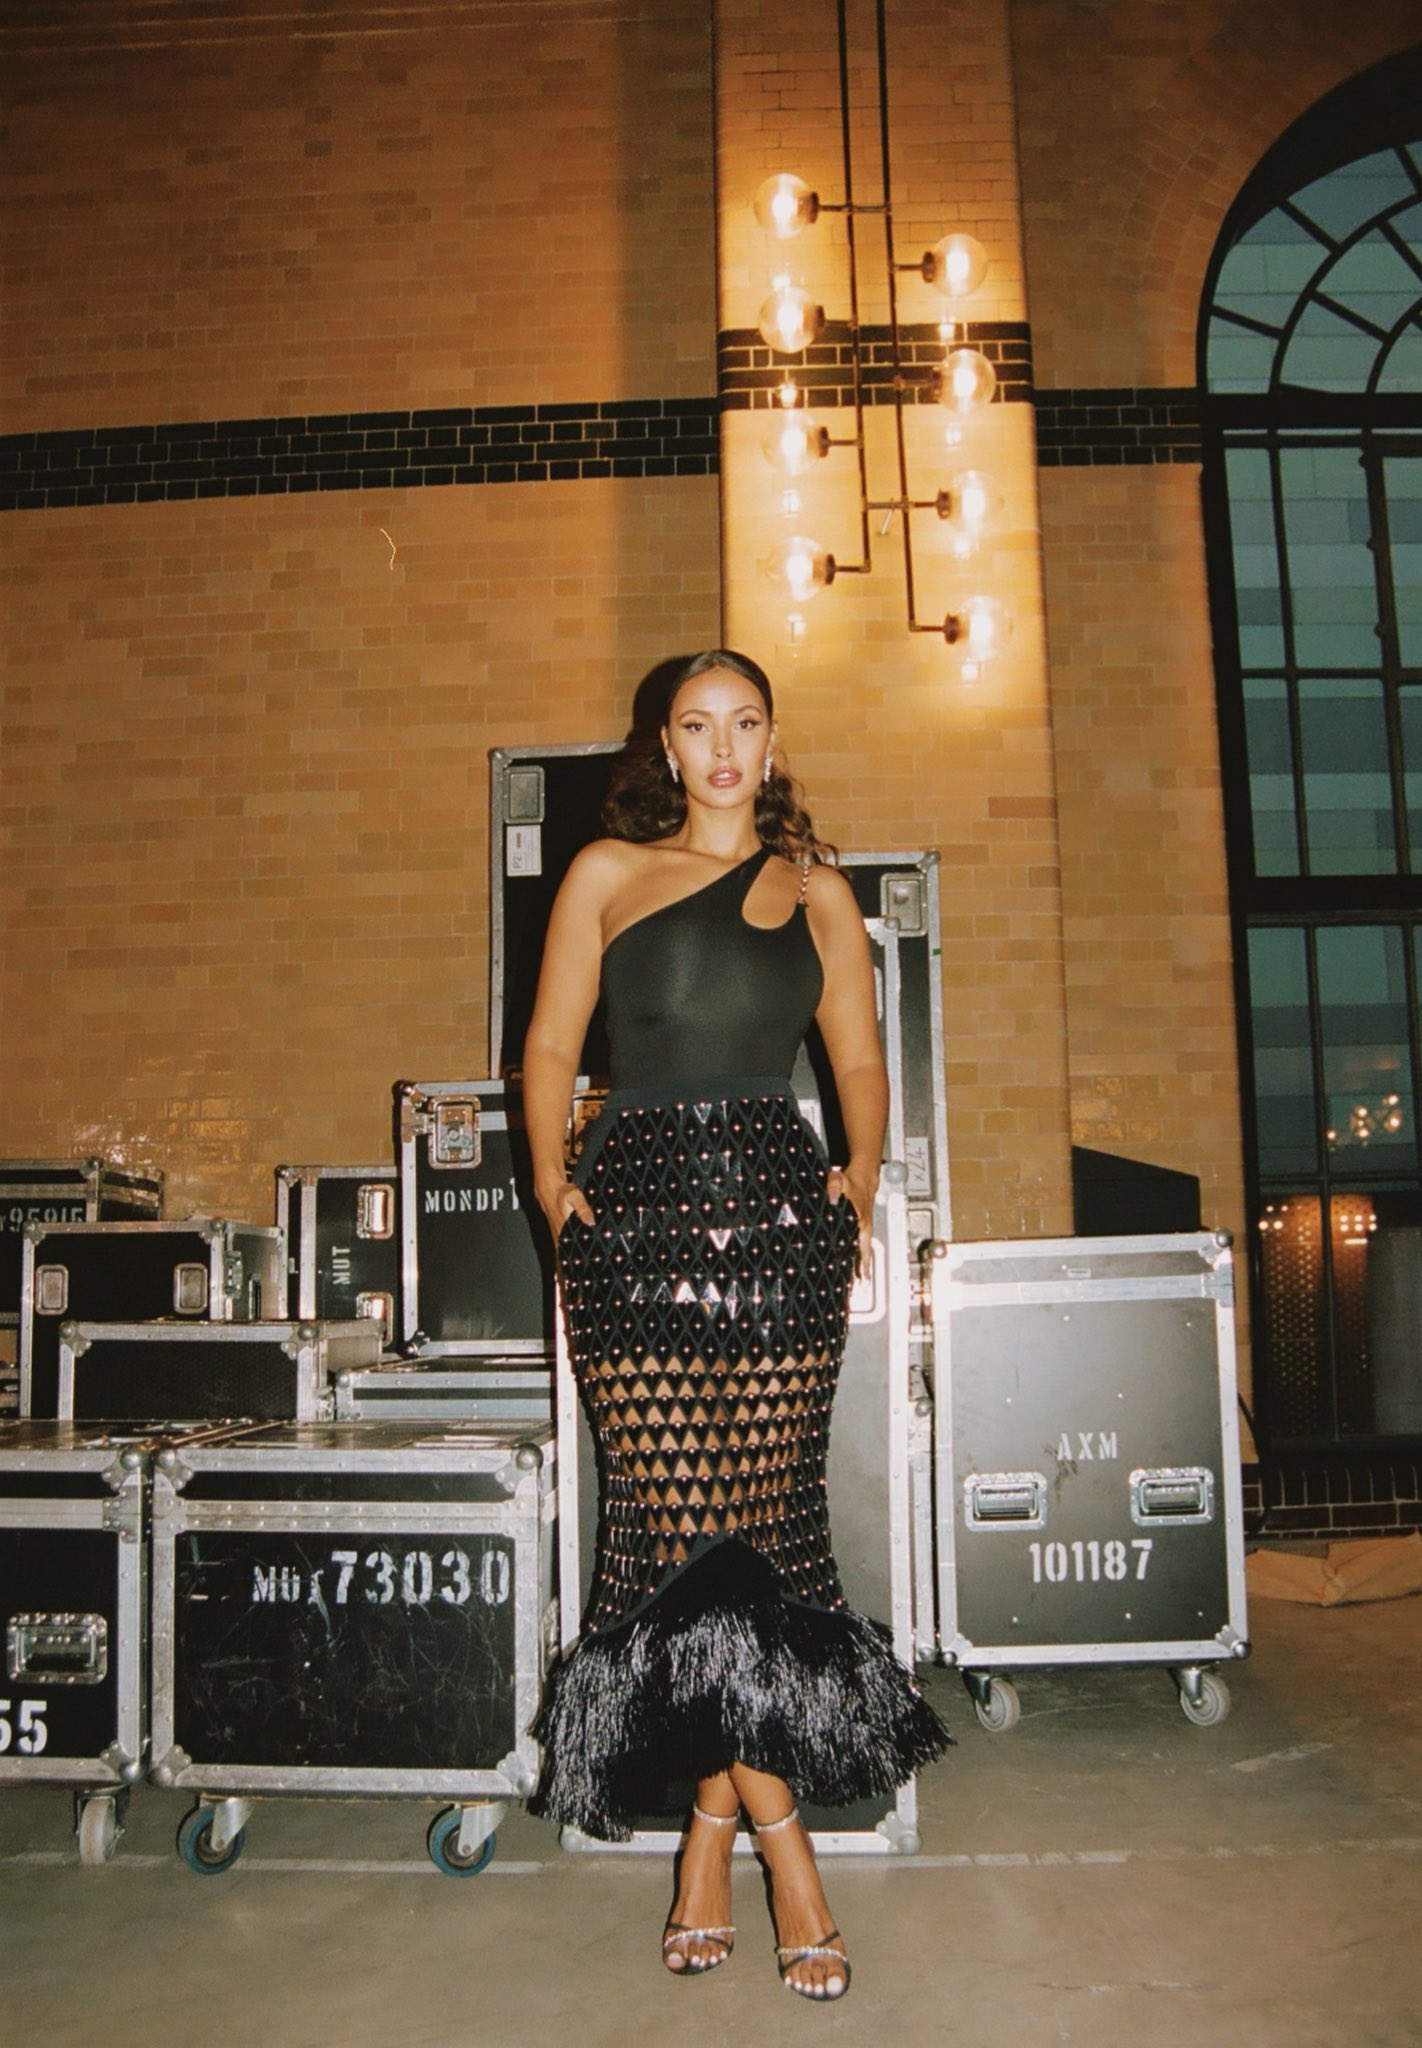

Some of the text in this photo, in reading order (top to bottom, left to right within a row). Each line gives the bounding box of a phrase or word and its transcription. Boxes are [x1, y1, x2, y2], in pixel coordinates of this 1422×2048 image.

[332, 1245, 351, 1285] MUT
[1057, 1431, 1118, 1461] AXM
[1029, 1538, 1153, 1583] 101187
